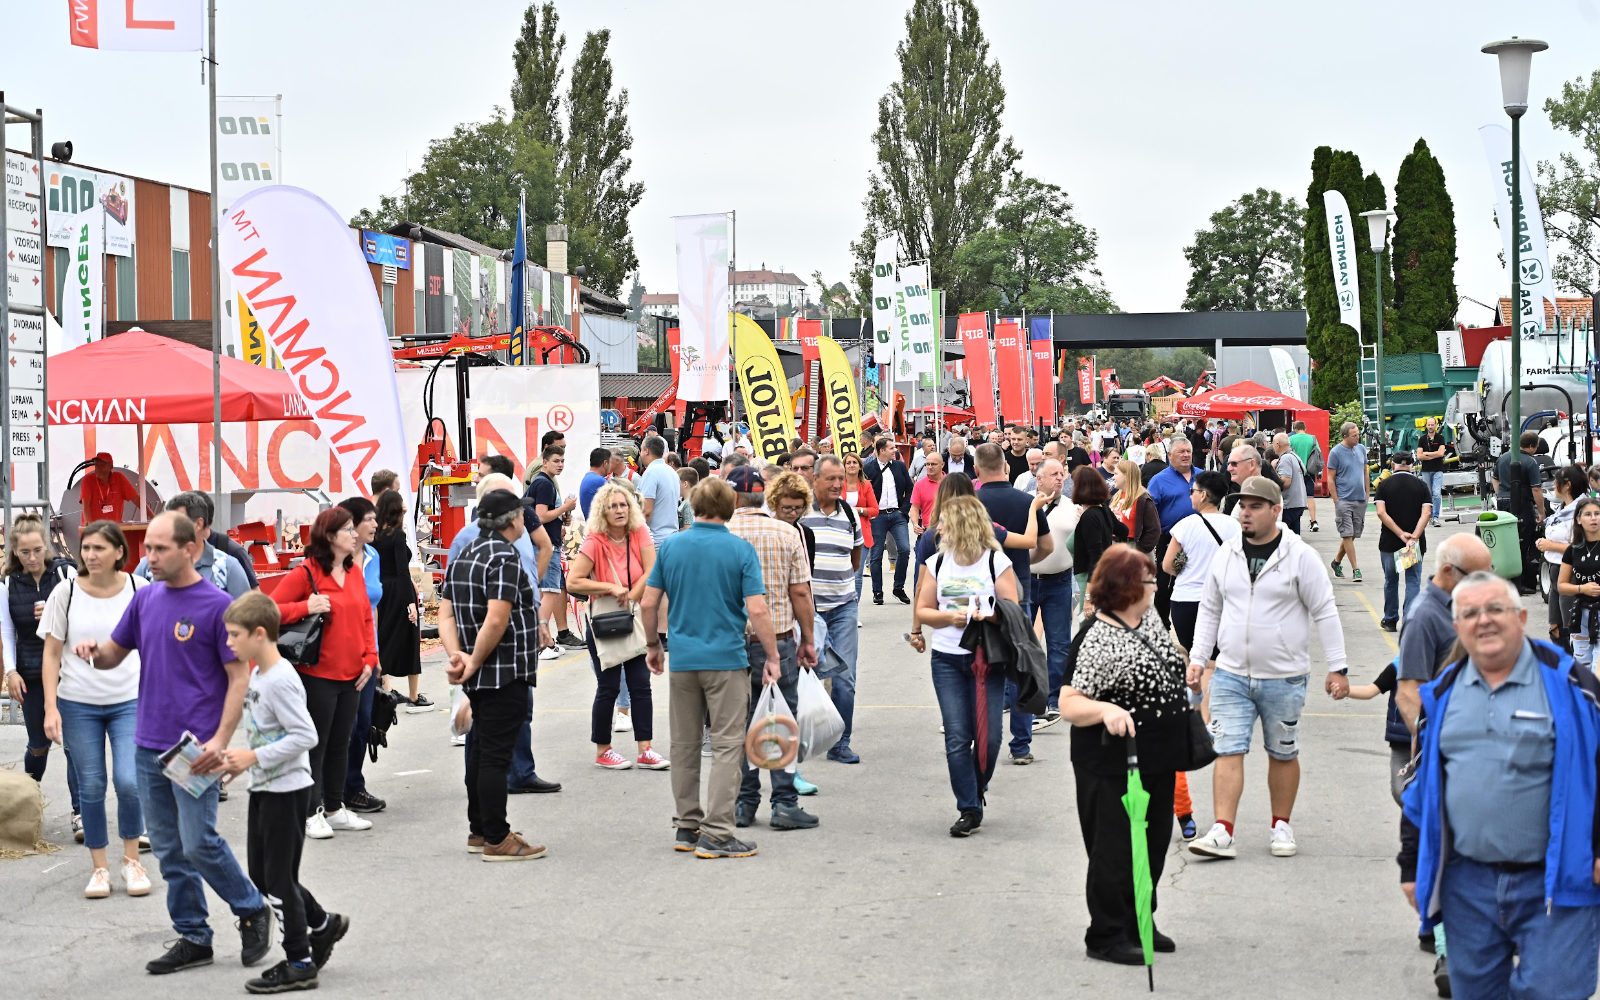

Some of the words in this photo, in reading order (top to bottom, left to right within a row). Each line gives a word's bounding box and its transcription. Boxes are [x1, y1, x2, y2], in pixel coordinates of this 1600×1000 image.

[49, 173, 94, 214] ino
[7, 198, 38, 215] RECEPCIJA
[18, 251, 41, 265] NASADI
[572, 288, 579, 313] A
[13, 318, 42, 331] DVORANA
[29, 358, 42, 369] Hala
[11, 395, 34, 406] UPRAVA
[1210, 393, 1287, 406] Coca-Cola
[11, 409, 28, 421] SEJMA
[47, 398, 146, 424] NCMAN
[12, 432, 30, 442] PRESS
[12, 445, 36, 457] CENTER
